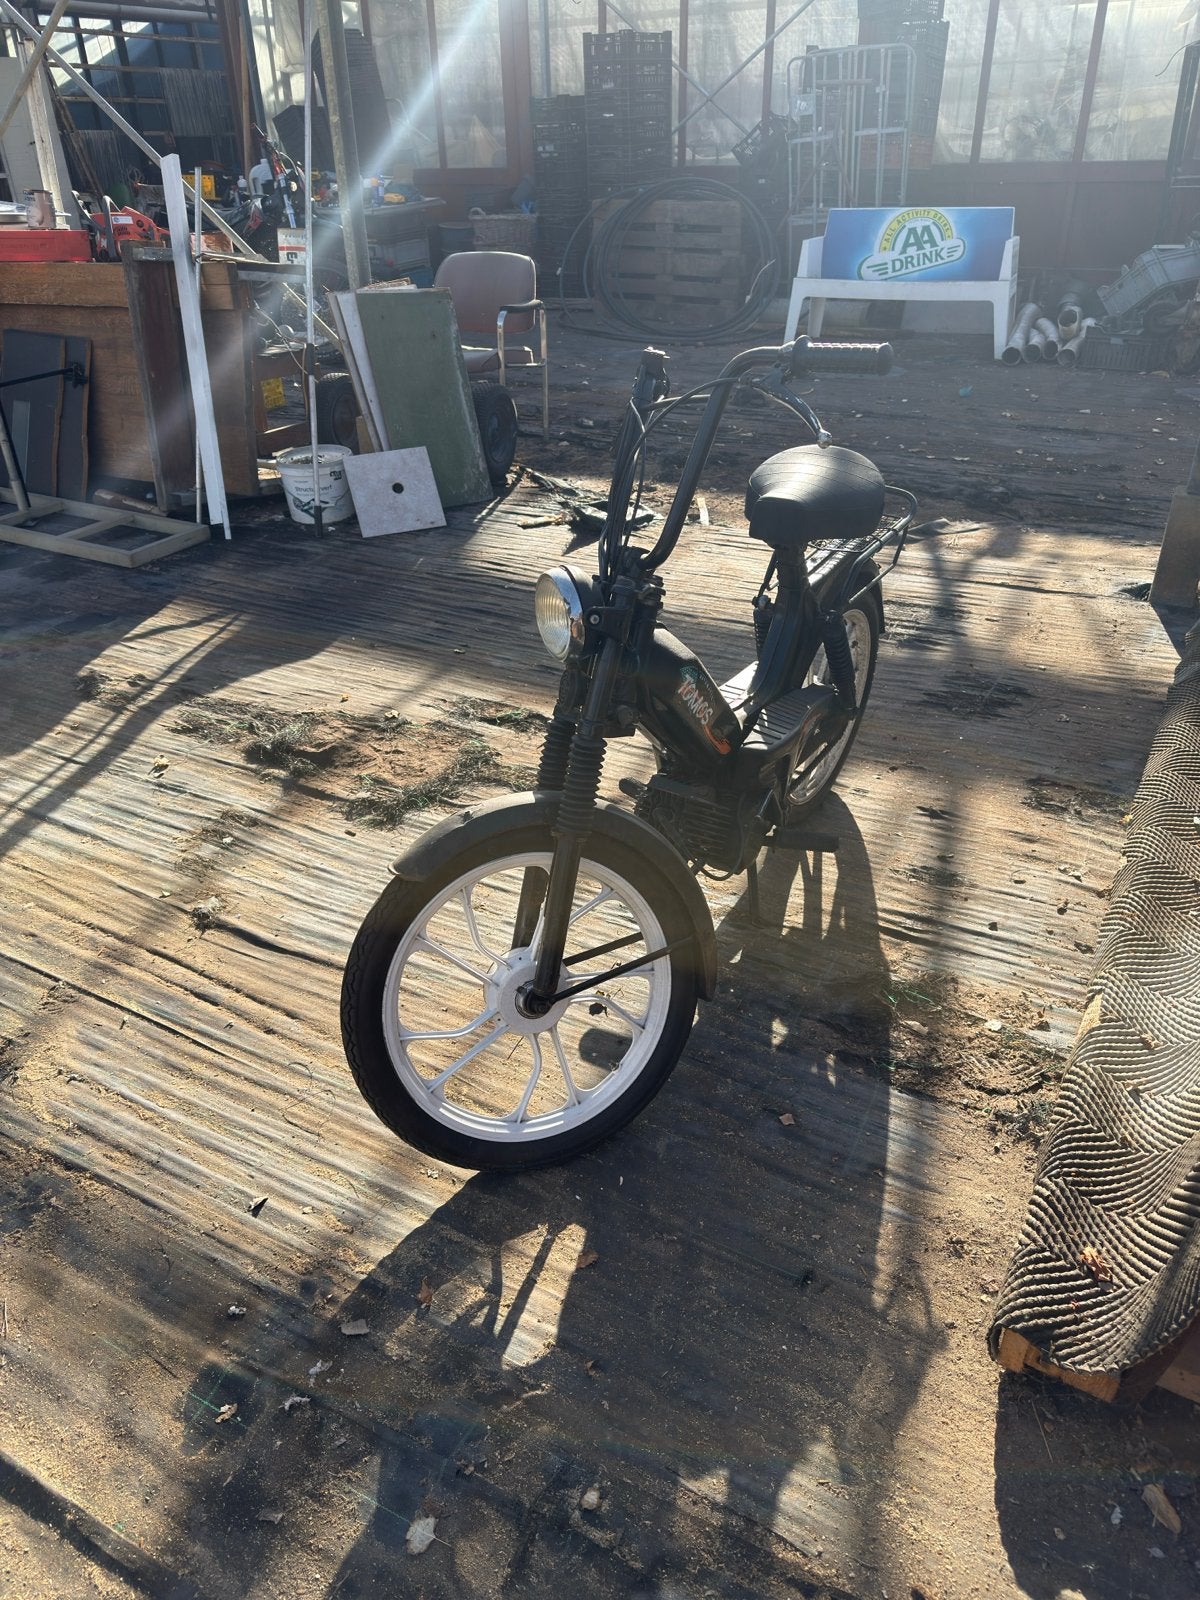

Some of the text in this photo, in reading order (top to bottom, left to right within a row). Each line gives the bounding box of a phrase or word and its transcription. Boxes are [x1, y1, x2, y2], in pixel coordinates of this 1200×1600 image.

[884, 226, 896, 243] ALL
[896, 209, 931, 226] ACTIVITY
[899, 224, 939, 255] AA
[891, 247, 946, 273] DRINK
[677, 674, 713, 725] TOMOS
